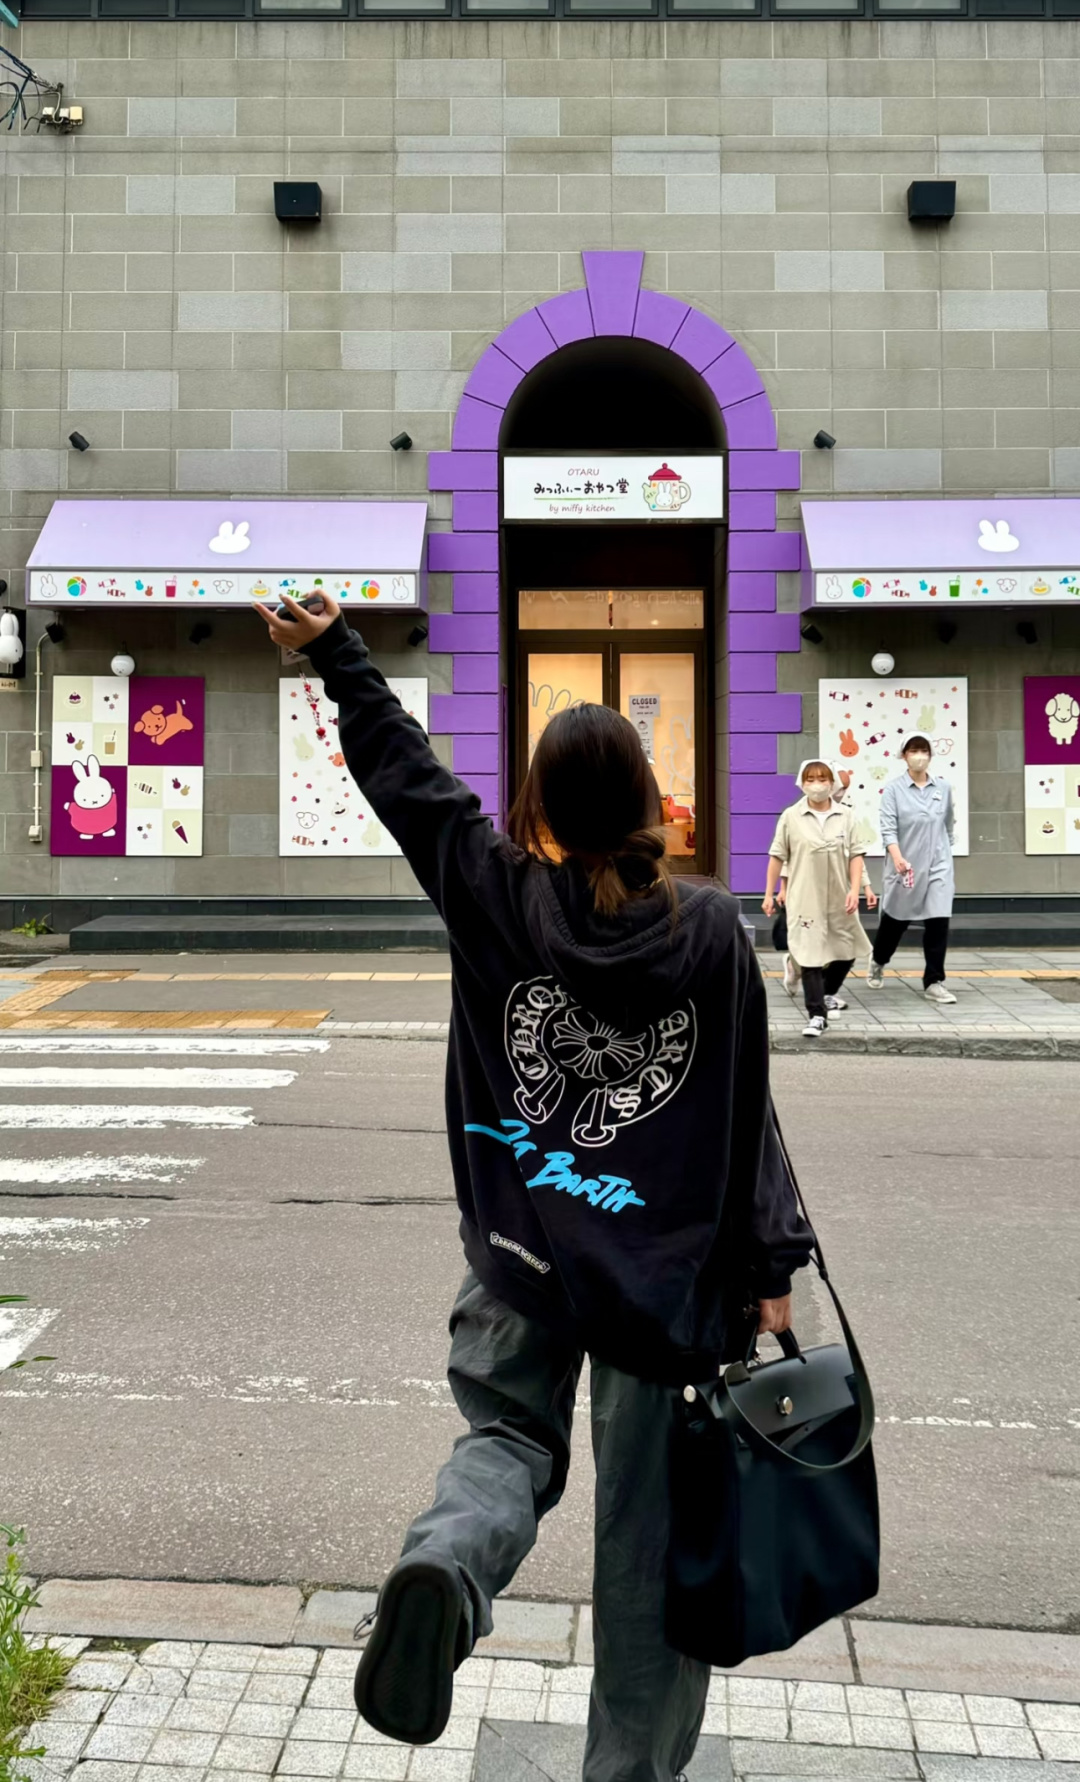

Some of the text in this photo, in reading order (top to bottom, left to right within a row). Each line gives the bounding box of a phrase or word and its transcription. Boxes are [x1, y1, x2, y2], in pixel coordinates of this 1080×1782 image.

[567, 468, 600, 476] OTARU
[533, 478, 630, 495] みっふぃーおやつ堂
[549, 504, 616, 514] by miffy kitchen
[631, 697, 658, 705] CLOSED
